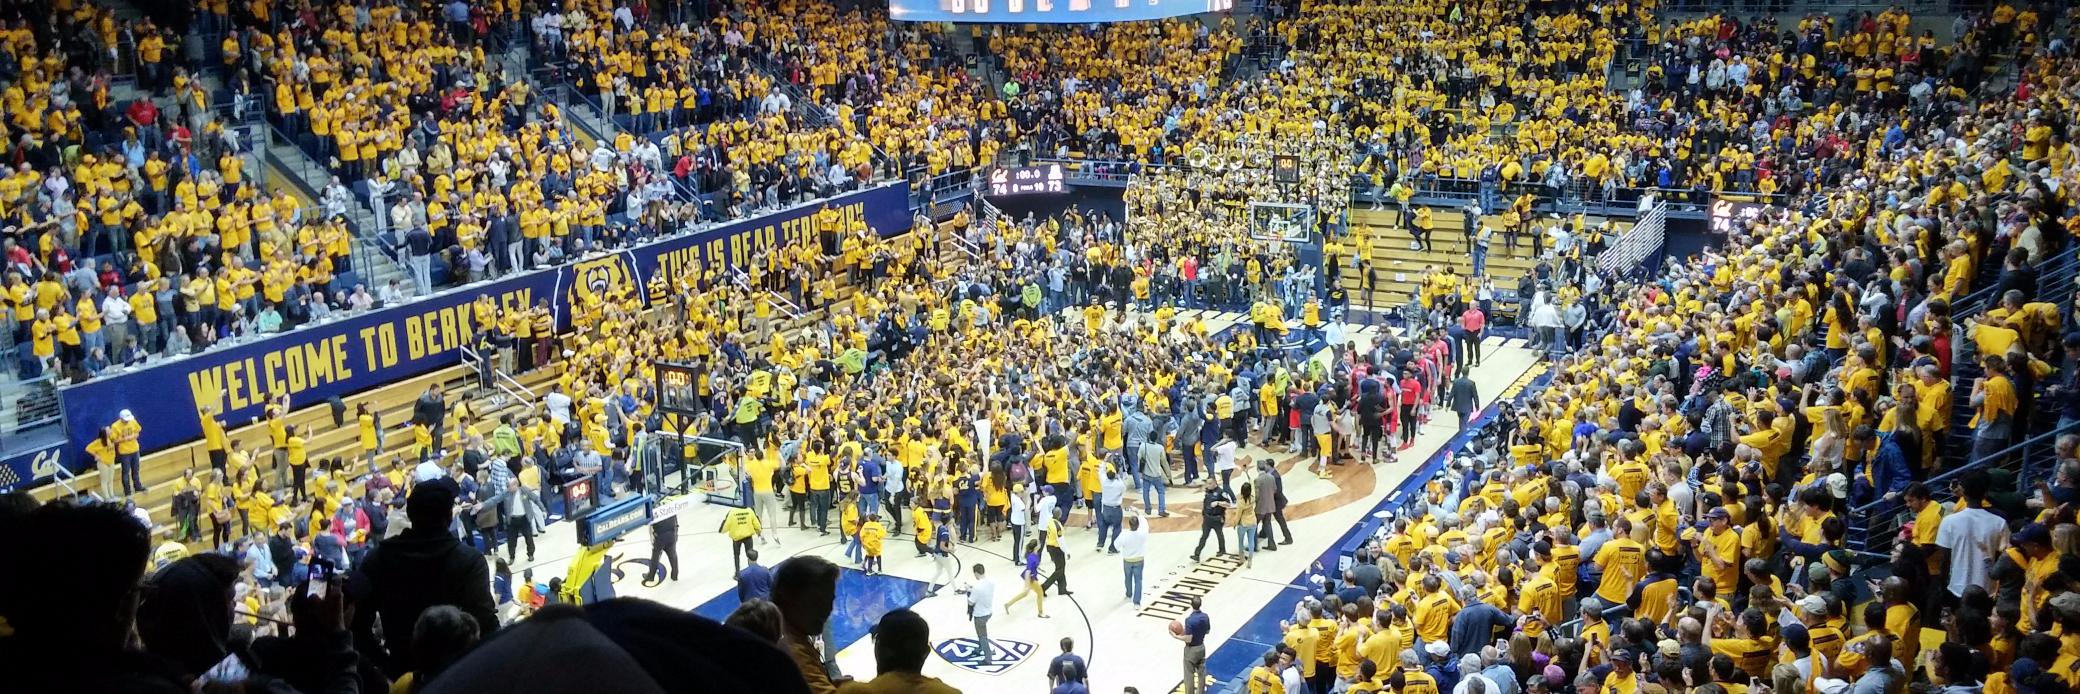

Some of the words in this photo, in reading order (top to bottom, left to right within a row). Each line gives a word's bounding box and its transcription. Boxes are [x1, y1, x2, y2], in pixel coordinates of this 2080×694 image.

[993, 183, 1008, 195] 74
[1047, 179, 1062, 192] 73
[706, 239, 727, 274] IS
[730, 227, 776, 268] BEAR
[781, 202, 865, 251] TERRRY
[1713, 217, 1730, 231] 74
[188, 334, 352, 417] WELCOME
[360, 322, 398, 372] TO
[405, 288, 531, 361] BERKLEY
[32, 449, 61, 481] Cal
[1136, 577, 1220, 621] NEWELL
